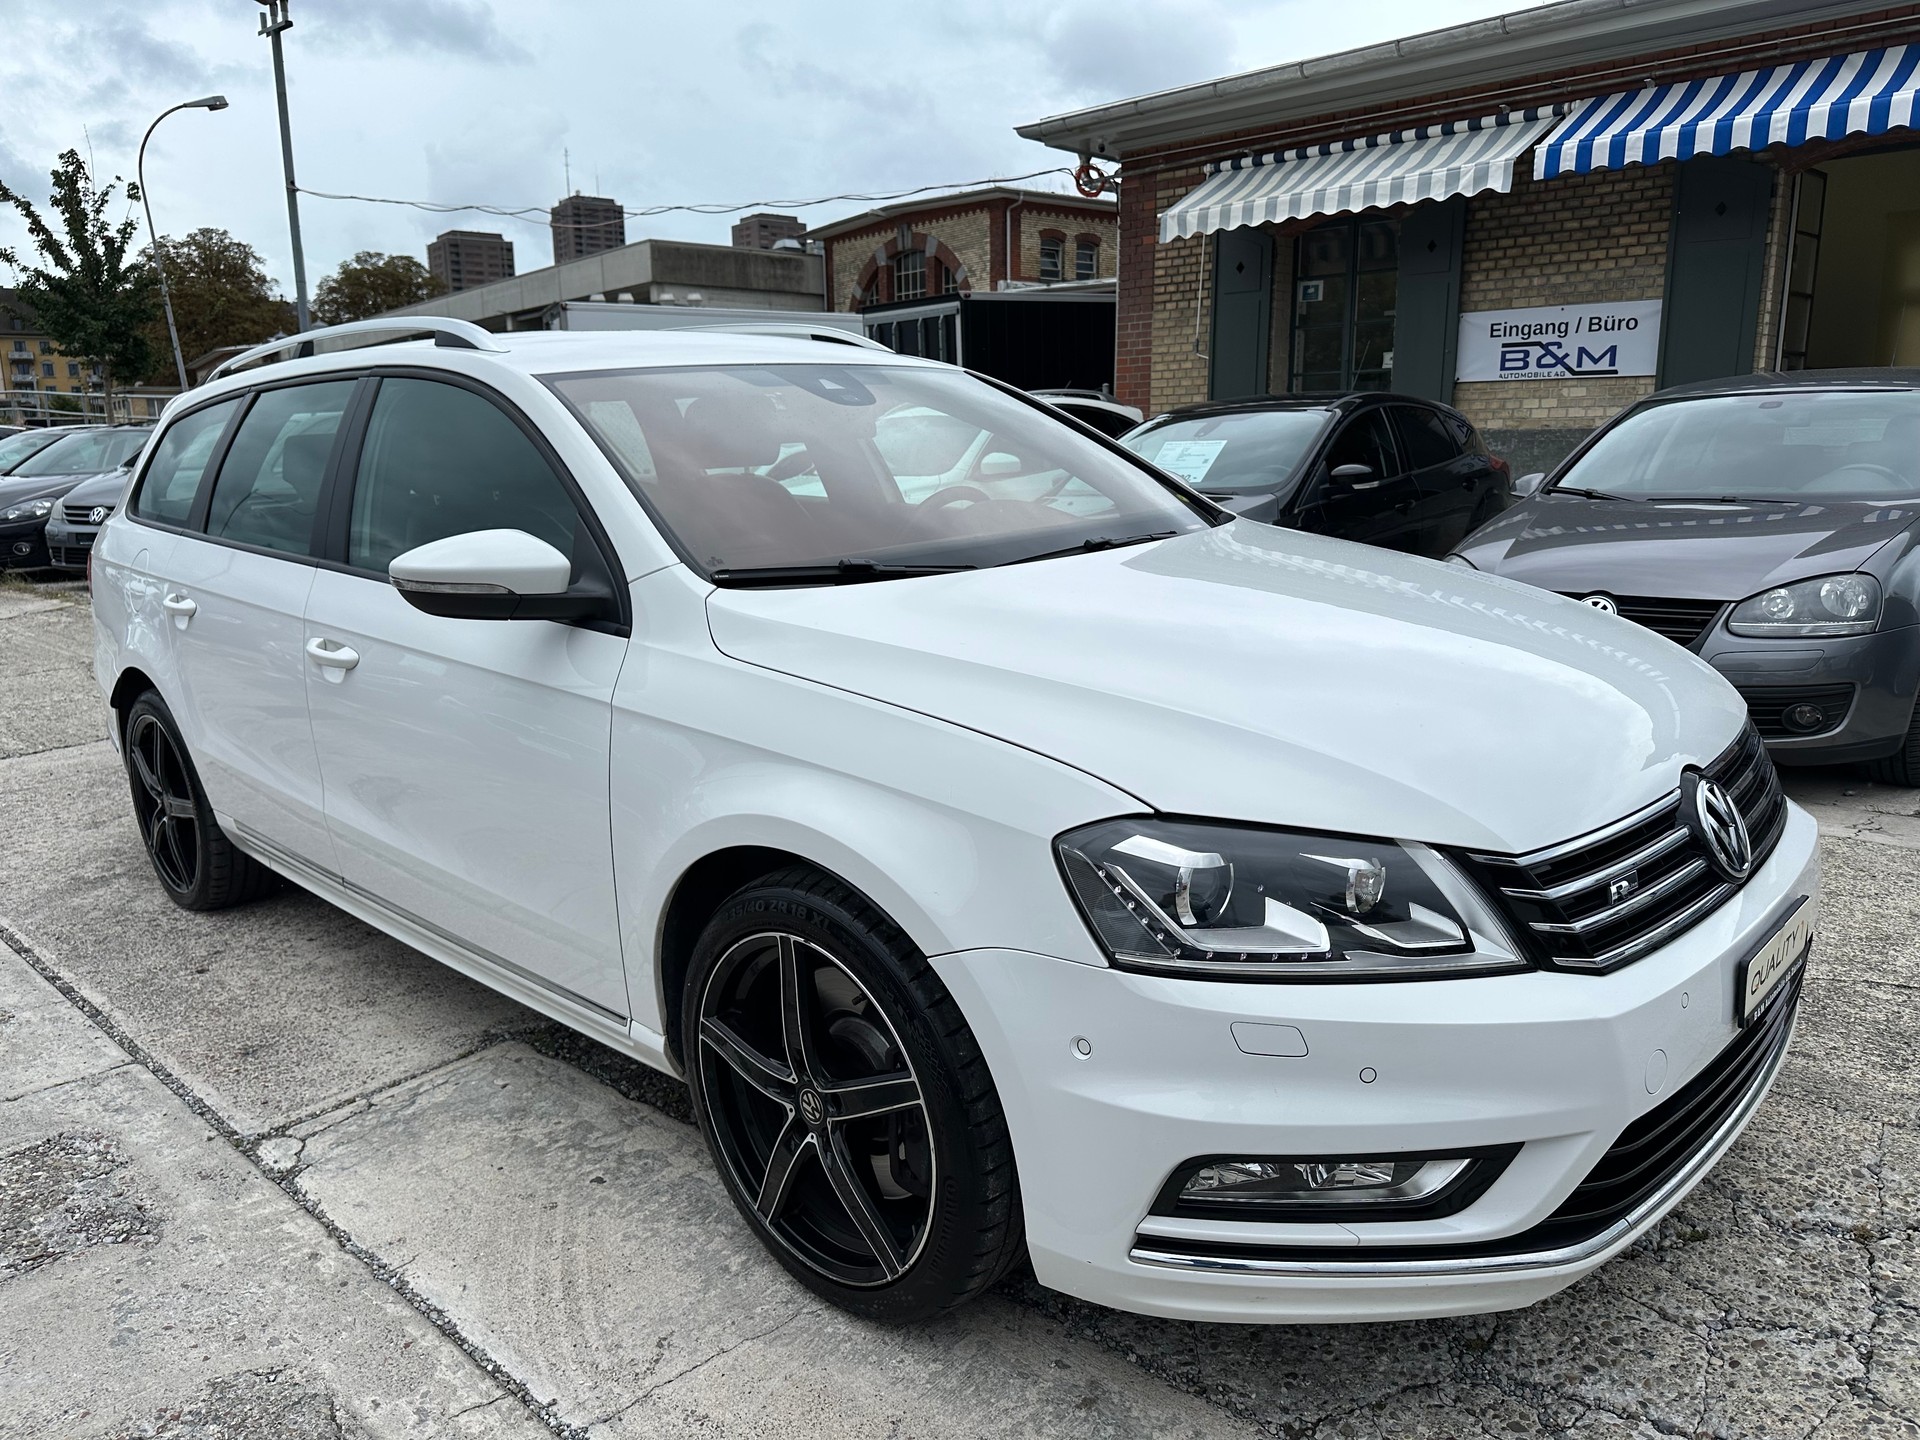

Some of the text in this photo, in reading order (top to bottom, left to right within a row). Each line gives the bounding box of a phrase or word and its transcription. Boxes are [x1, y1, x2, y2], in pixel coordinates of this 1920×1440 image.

[1489, 315, 1639, 340] Eingang / Büro
[1499, 341, 1618, 372] B&M
[1498, 370, 1566, 379] AUTOMOBILE AG
[1750, 924, 1800, 995] QUALITY
